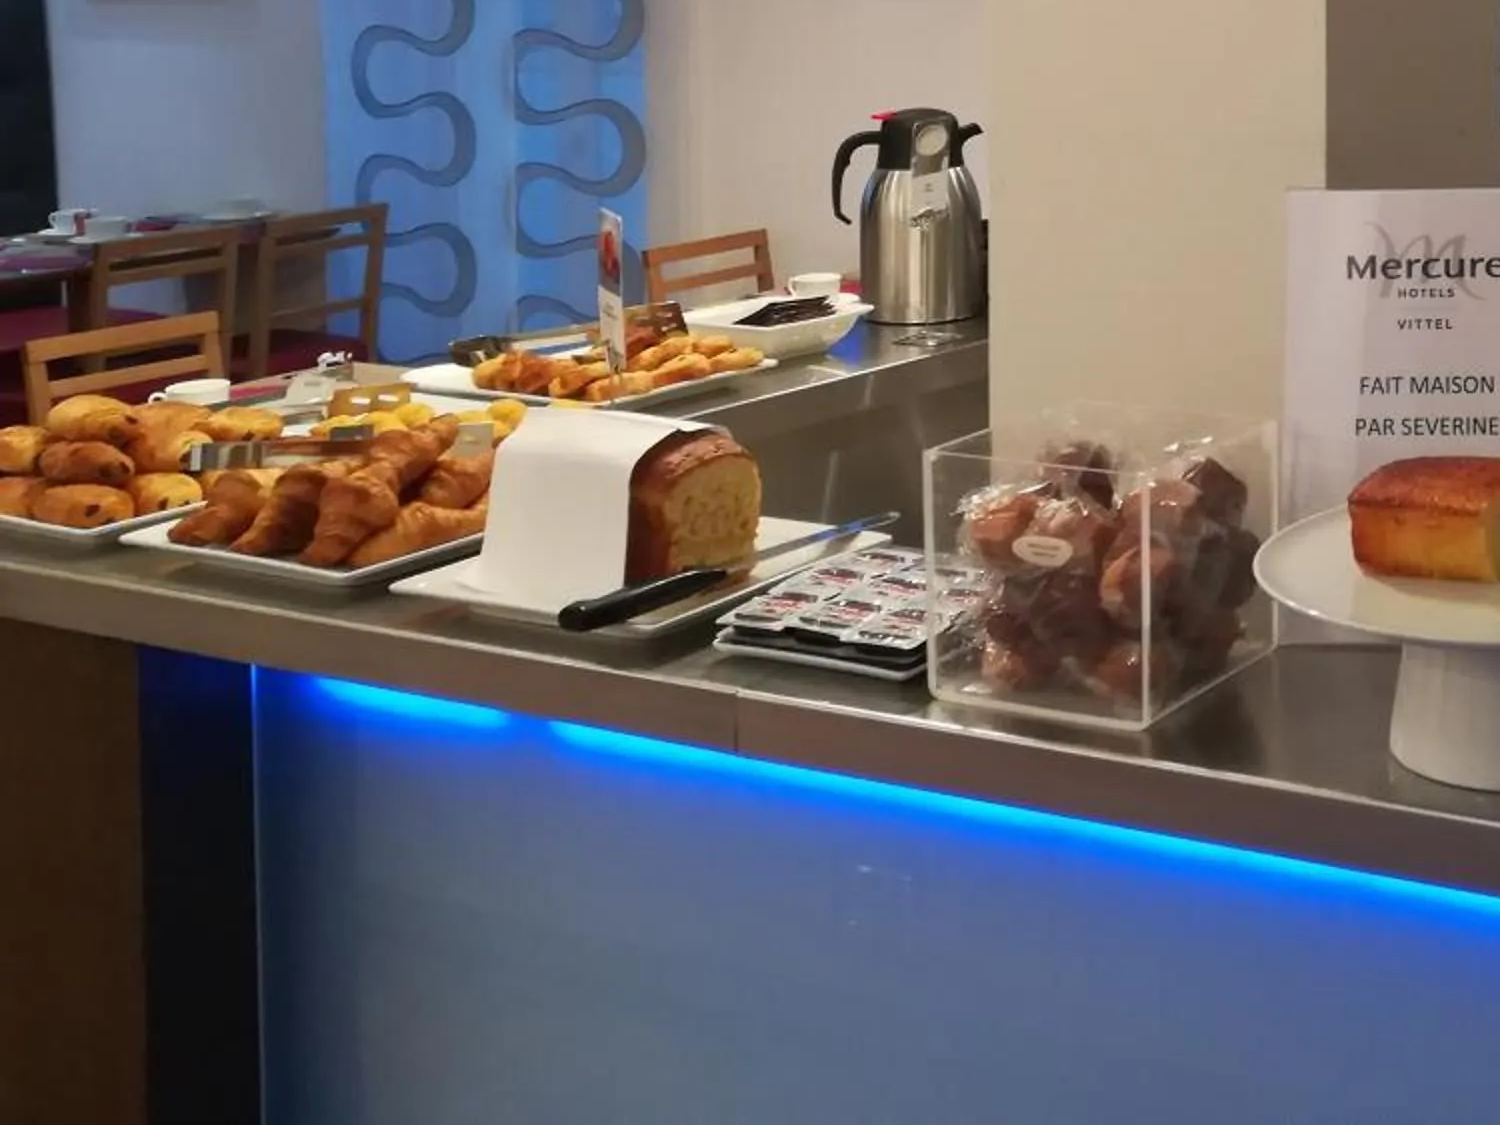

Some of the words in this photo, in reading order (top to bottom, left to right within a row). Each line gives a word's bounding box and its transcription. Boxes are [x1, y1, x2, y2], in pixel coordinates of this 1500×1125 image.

[1397, 287, 1456, 299] HOTELS
[1397, 318, 1454, 331] VITTEL
[1358, 376, 1402, 395] FAIT
[1409, 375, 1496, 395] MAISON
[1354, 418, 1395, 437] PAR
[1401, 416, 1500, 437] SEVERINE
